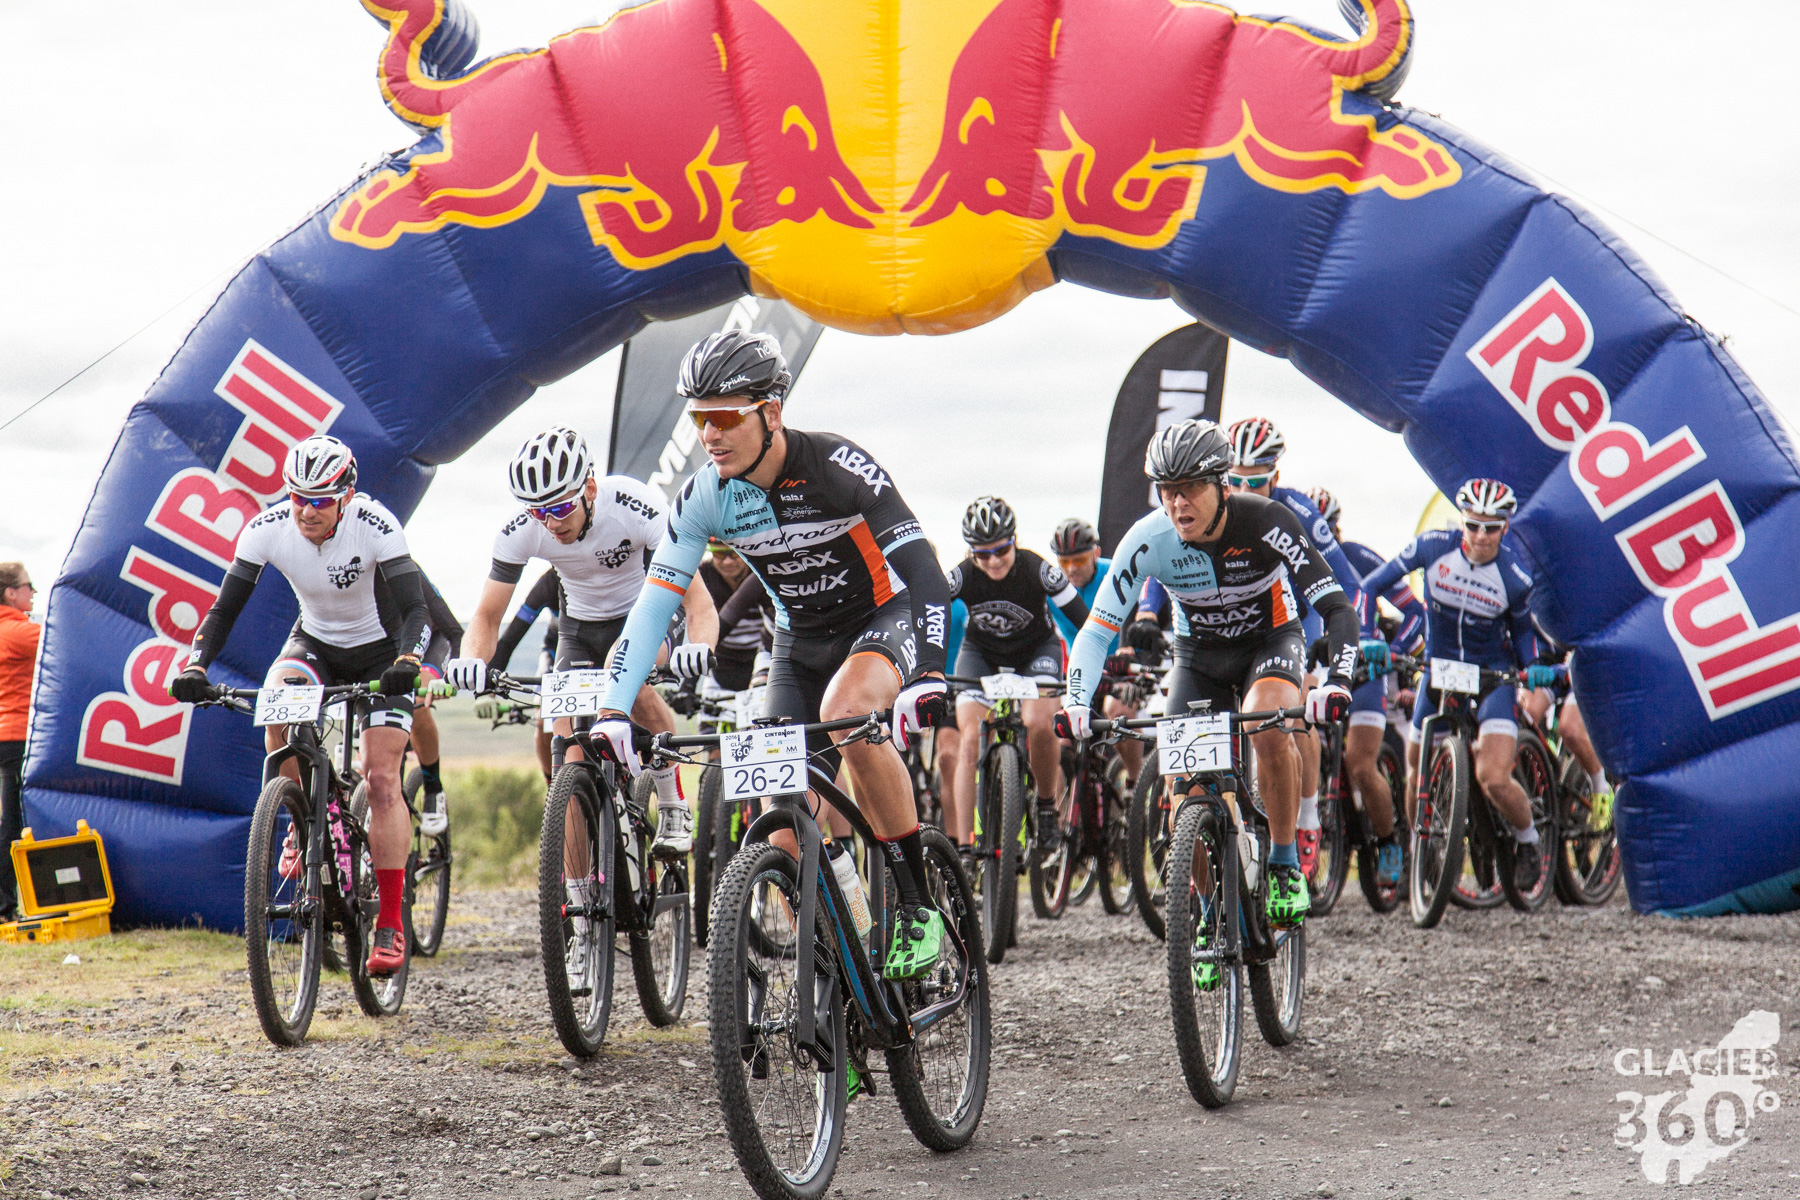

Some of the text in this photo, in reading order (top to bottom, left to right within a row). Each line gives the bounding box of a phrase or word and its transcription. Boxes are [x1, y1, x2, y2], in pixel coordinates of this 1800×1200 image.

[829, 445, 892, 497] ABAX
[250, 508, 290, 529] WOW
[616, 490, 659, 521] WOW
[735, 506, 768, 521] SHIMANO
[357, 507, 394, 536] WOW
[767, 550, 840, 577] ABAX
[1261, 526, 1310, 575] ABAX
[925, 604, 945, 649] ABAX
[1190, 602, 1262, 625] ABAX
[263, 704, 311, 722] 28-2
[550, 694, 598, 715] 28-1
[1168, 745, 1218, 770] 26-1
[734, 763, 796, 795] 26-2
